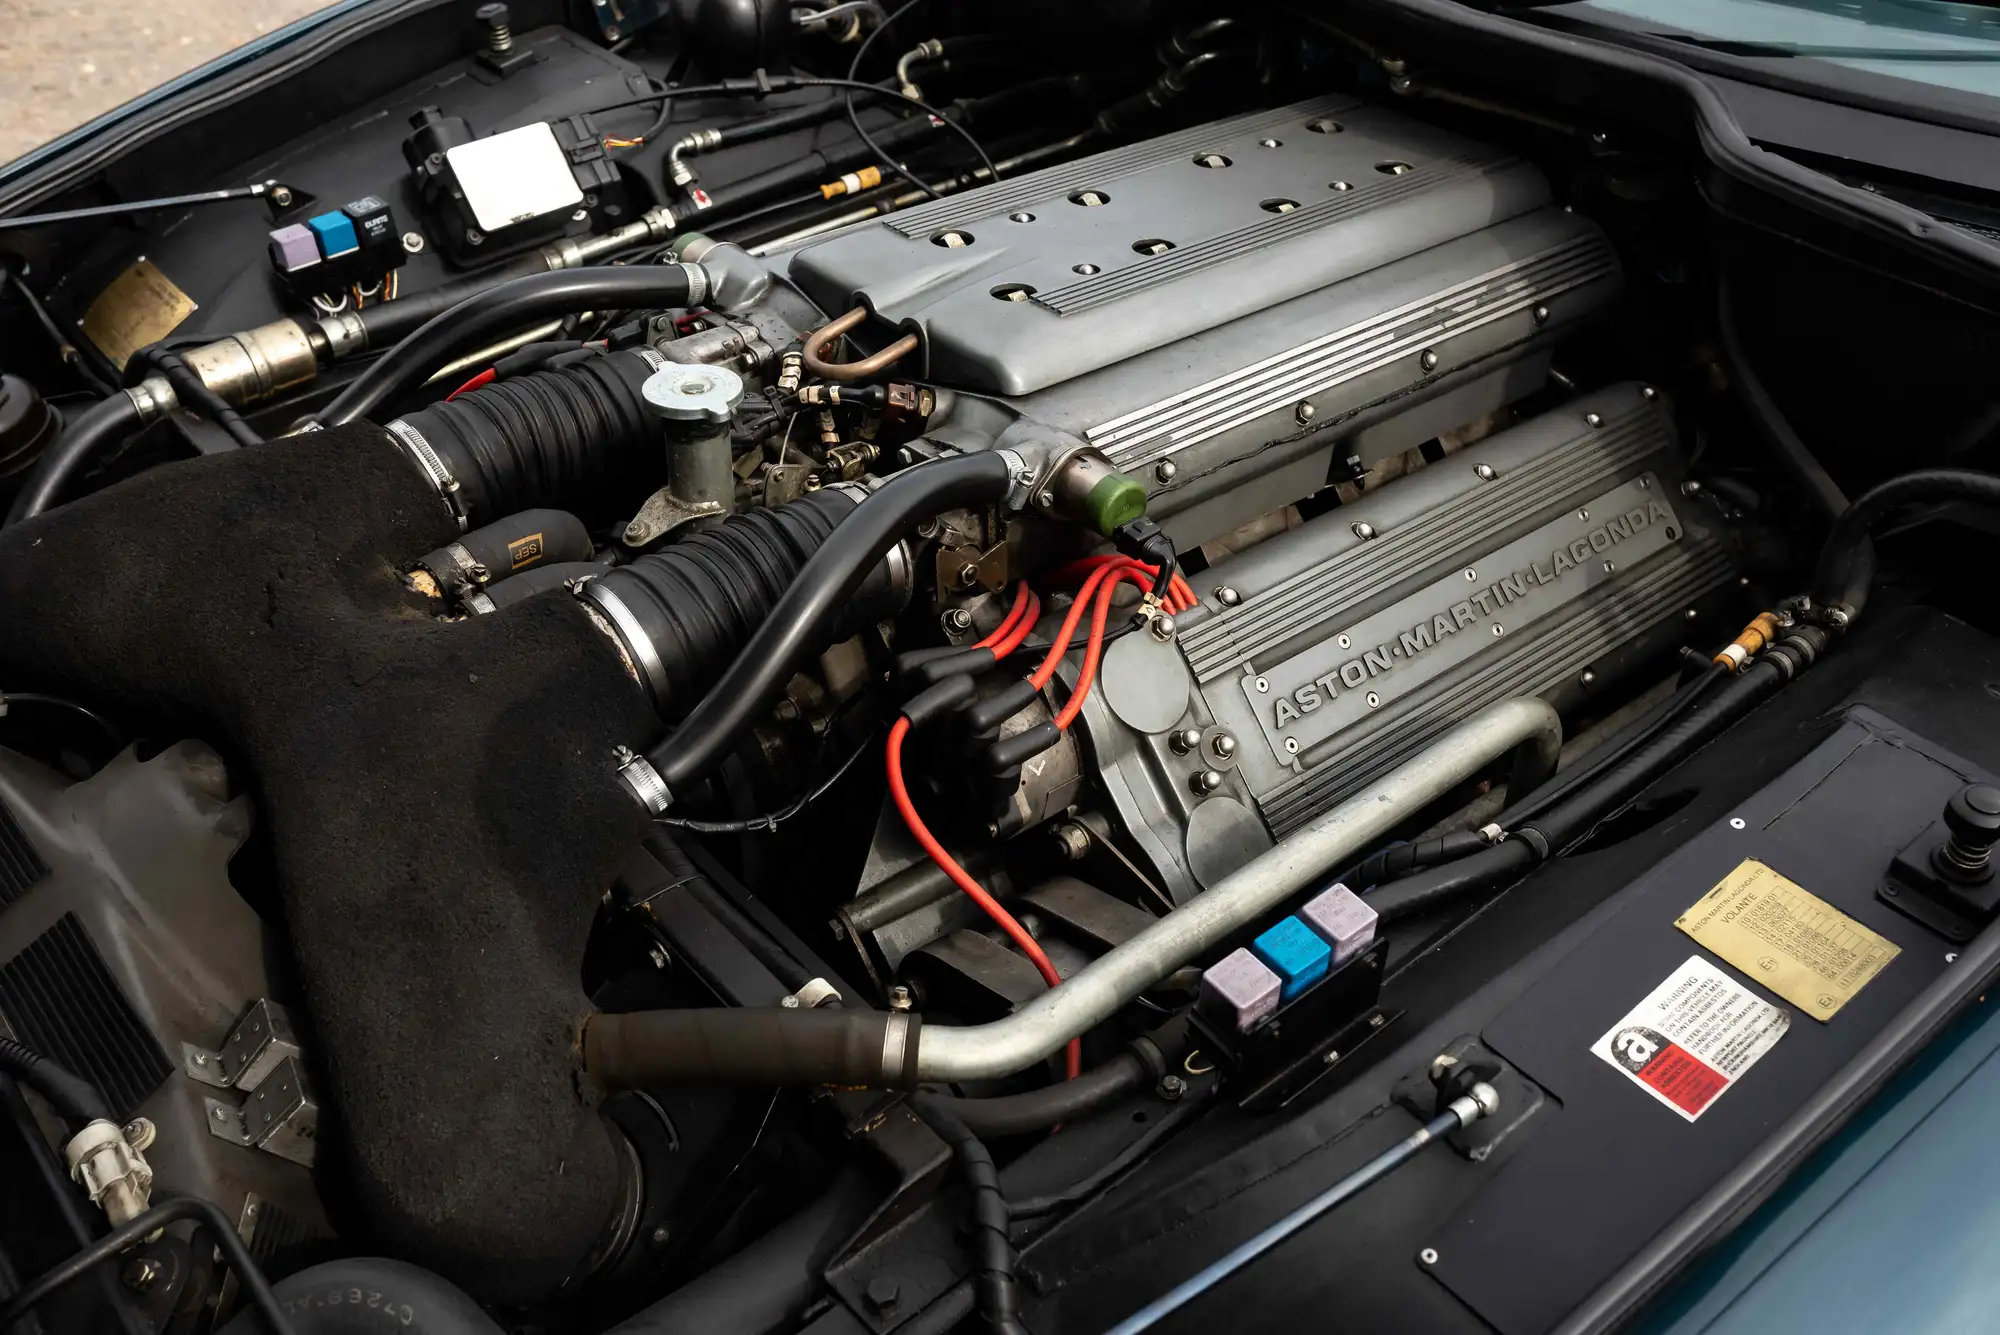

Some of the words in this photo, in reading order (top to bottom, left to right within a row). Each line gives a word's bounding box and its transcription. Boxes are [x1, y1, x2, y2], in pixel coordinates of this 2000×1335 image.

[1689, 915, 1711, 933] ASTON
[1707, 897, 1731, 917] MARTIN
[1727, 876, 1755, 900] LAGONDA
[1751, 867, 1765, 878] LTD
[1720, 892, 1757, 924] VOLANTE
[1740, 916, 1751, 925] 10
[1748, 922, 1760, 930] 12
[1757, 927, 1768, 935] 13
[1765, 933, 1776, 941] 14
[1774, 937, 1786, 946] 17
[1707, 979, 1724, 992] MAY
[1657, 975, 1698, 1011] WARNING
[1671, 1012, 1700, 1038] CONTAIN
[1696, 987, 1727, 1015] ASBESTOS
[1698, 1021, 1709, 1029] TO
[1706, 1012, 1719, 1023] THE
[1716, 991, 1741, 1014] OWNERS
